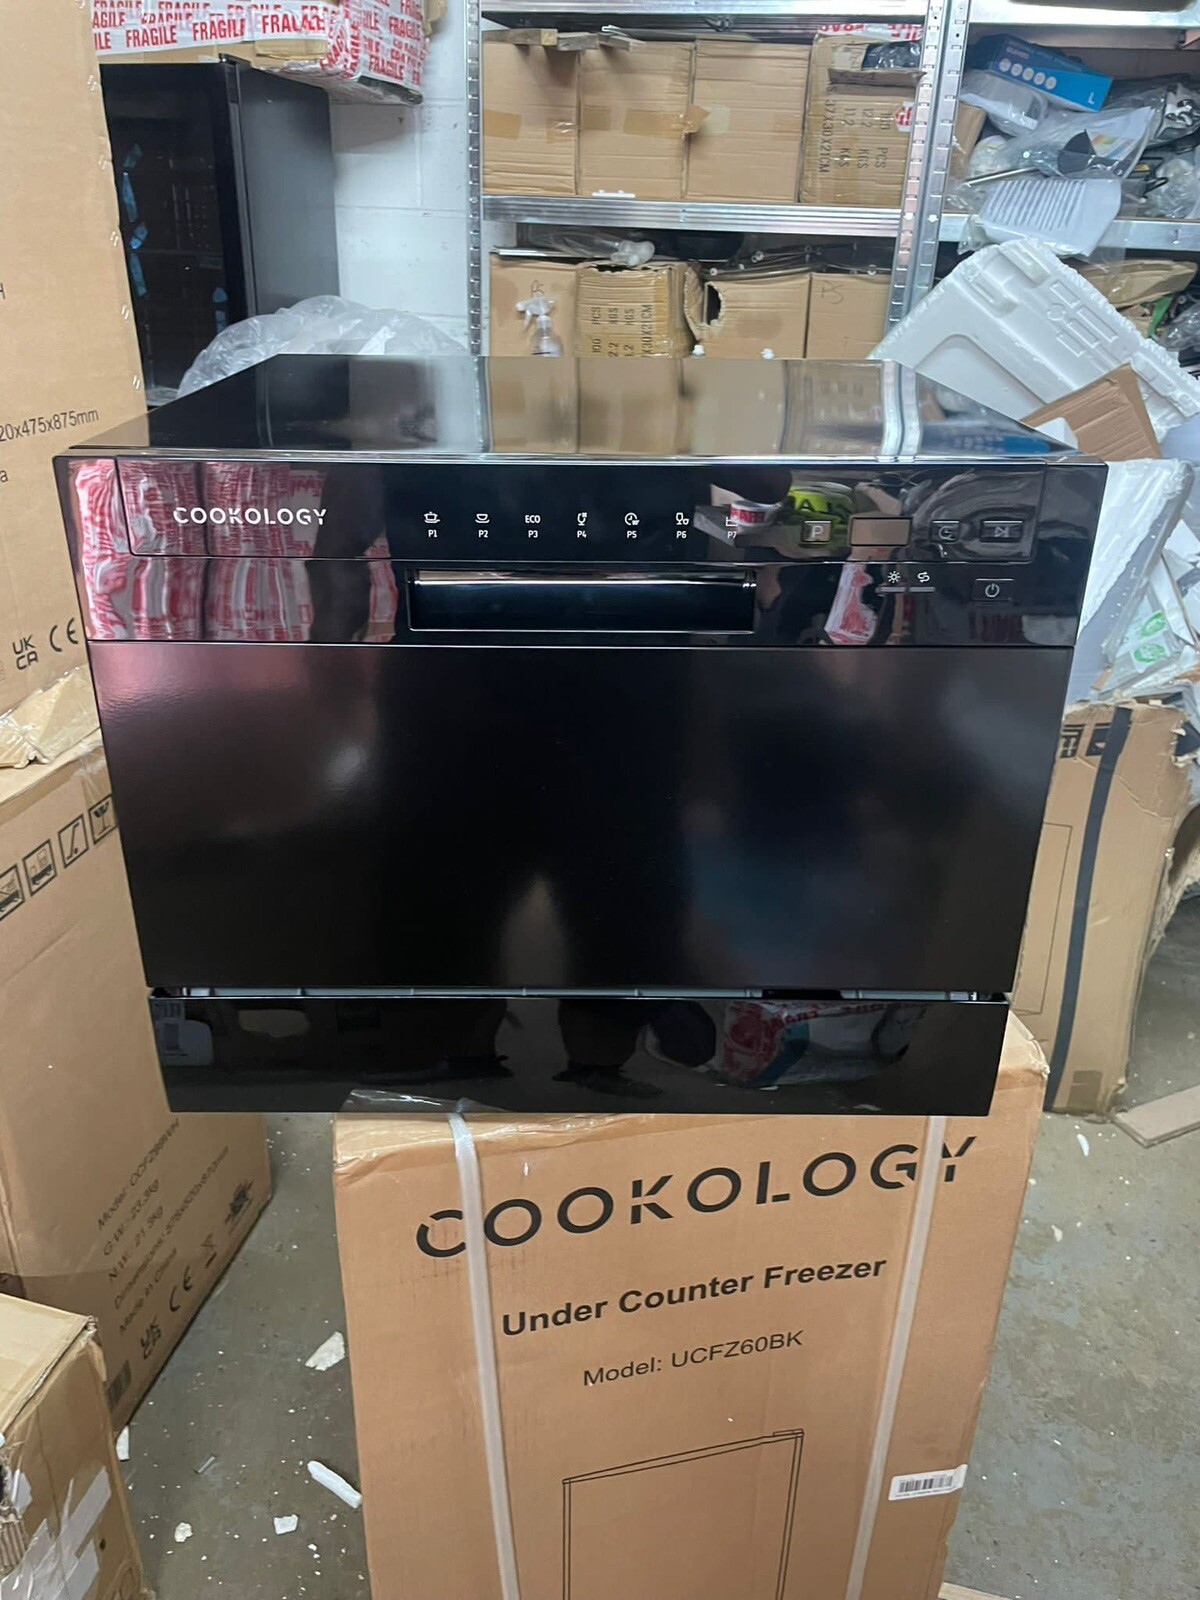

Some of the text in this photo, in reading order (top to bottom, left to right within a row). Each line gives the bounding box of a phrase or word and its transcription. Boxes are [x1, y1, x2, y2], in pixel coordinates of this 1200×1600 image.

[125, 25, 178, 48] FRAGILE
[1087, 92, 1096, 105] L
[857, 148, 871, 169] KGS
[875, 146, 889, 169] PCS
[172, 506, 328, 526] COOKOLOGY
[524, 514, 541, 524] ECO
[427, 529, 438, 538] P1
[478, 529, 489, 538] P2
[527, 530, 539, 539] P3
[576, 530, 587, 539] P4
[626, 530, 638, 539] P5
[676, 531, 687, 539] P6
[727, 531, 737, 539] P7
[811, 525, 824, 538] P
[49, 617, 79, 652] CE
[416, 1135, 977, 1258] COOKOLOGY
[502, 1259, 888, 1336] Under Counter Freezer
[583, 1329, 805, 1386] Model: UCFZ60BK
